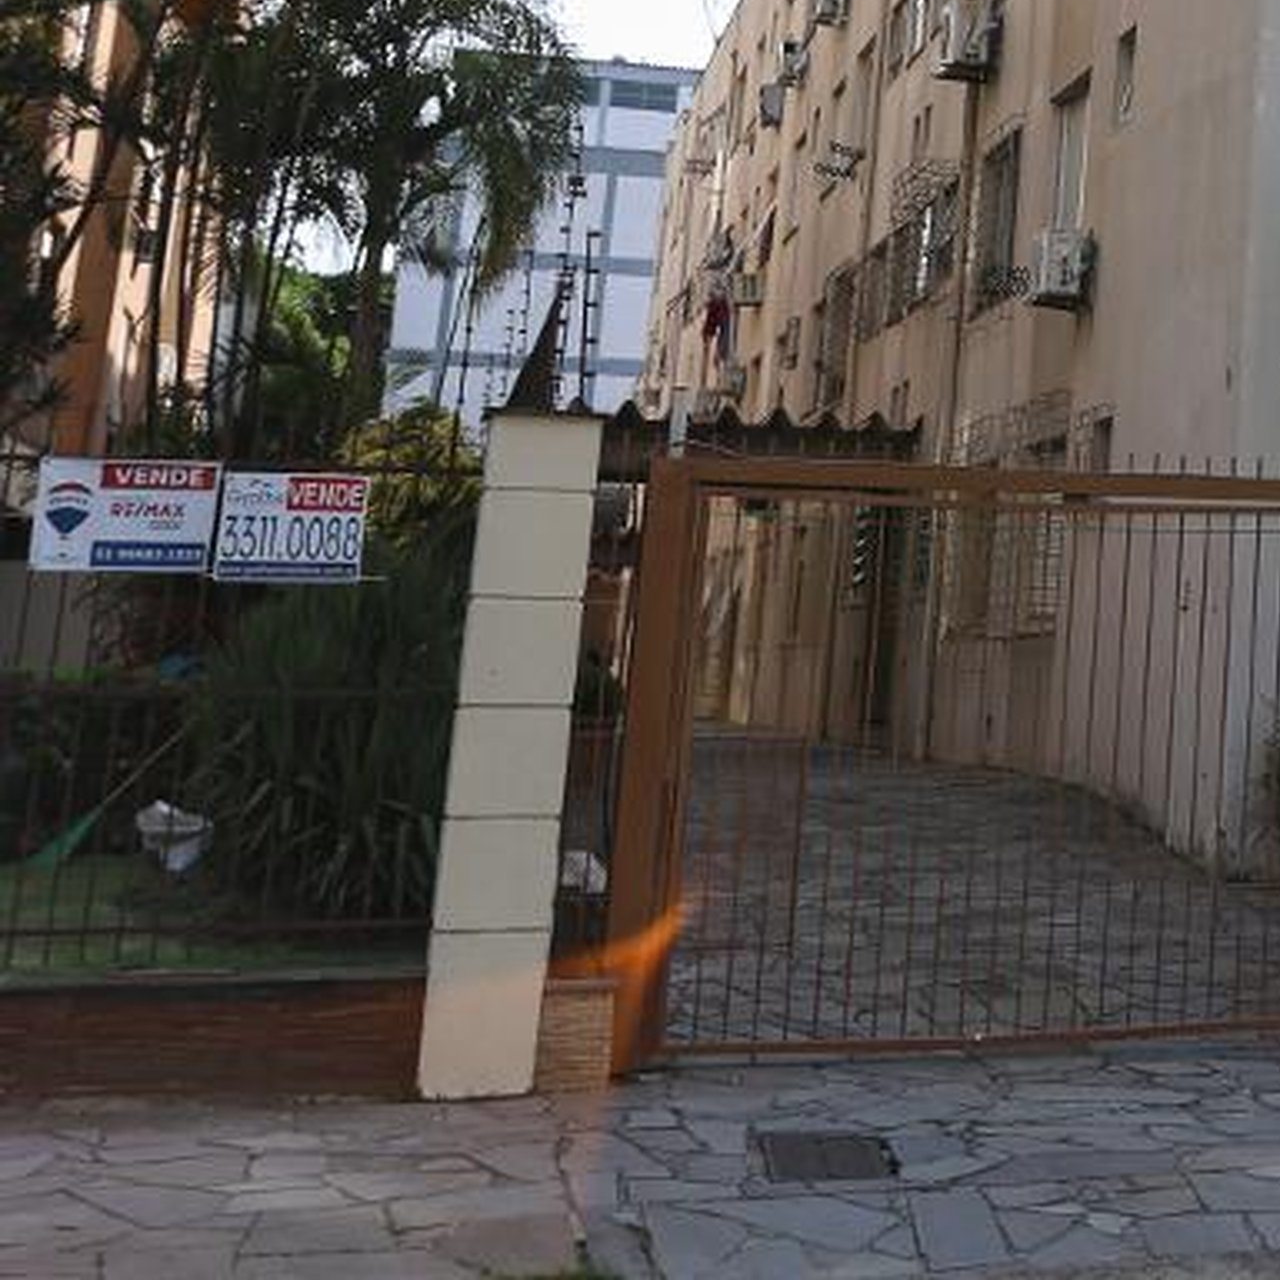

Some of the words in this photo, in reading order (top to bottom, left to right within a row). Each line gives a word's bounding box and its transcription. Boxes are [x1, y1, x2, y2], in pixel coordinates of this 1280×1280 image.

[115, 466, 206, 488] VENDE
[289, 481, 364, 508] VENDE
[109, 502, 186, 519] RE/MAX
[220, 514, 360, 561] 3311.0088
